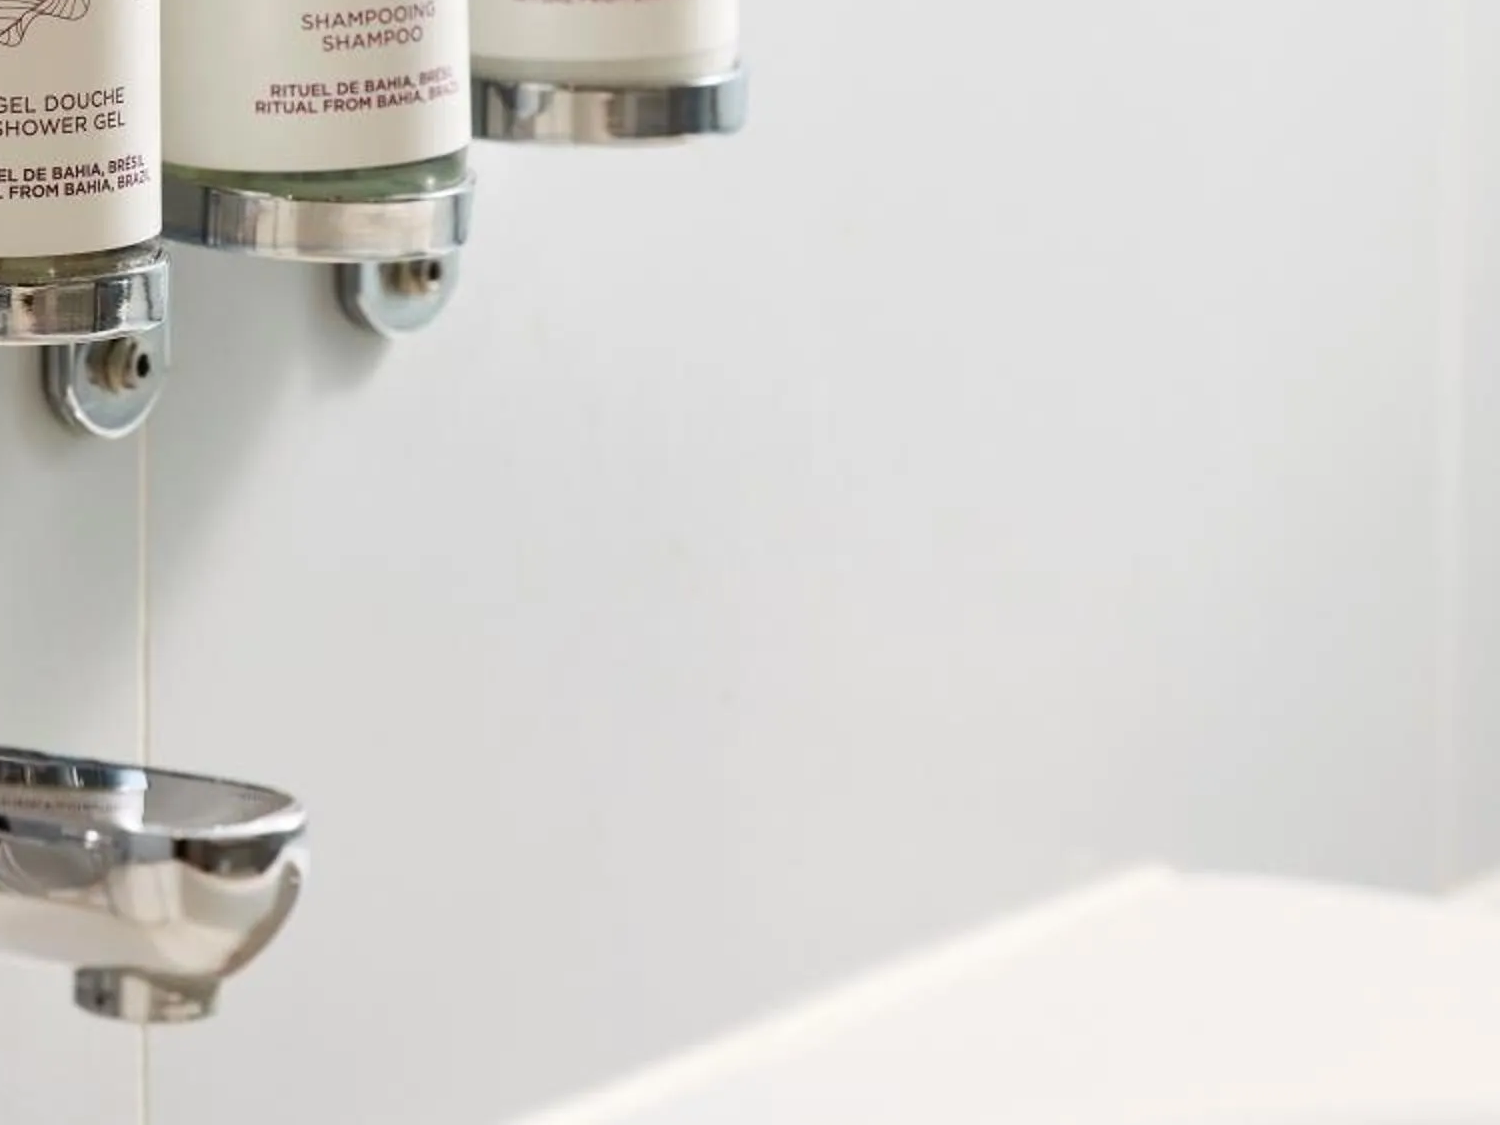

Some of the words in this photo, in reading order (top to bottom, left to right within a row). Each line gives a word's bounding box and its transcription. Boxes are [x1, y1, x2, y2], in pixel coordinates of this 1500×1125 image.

[301, 0, 436, 30] SHAMPOOING
[322, 26, 423, 52] SHAMPOO
[270, 84, 330, 98] RITUEL
[336, 82, 359, 96] DE
[364, 75, 416, 93] BAHIA,
[44, 86, 125, 112] DOUCHE
[255, 100, 317, 115] RITUAL
[323, 97, 372, 113] FROM
[93, 111, 126, 131] GEL
[23, 168, 47, 182] DE
[52, 161, 105, 181] BAHIA,
[9, 184, 59, 199] FROM
[63, 178, 115, 196] BAHIA,
